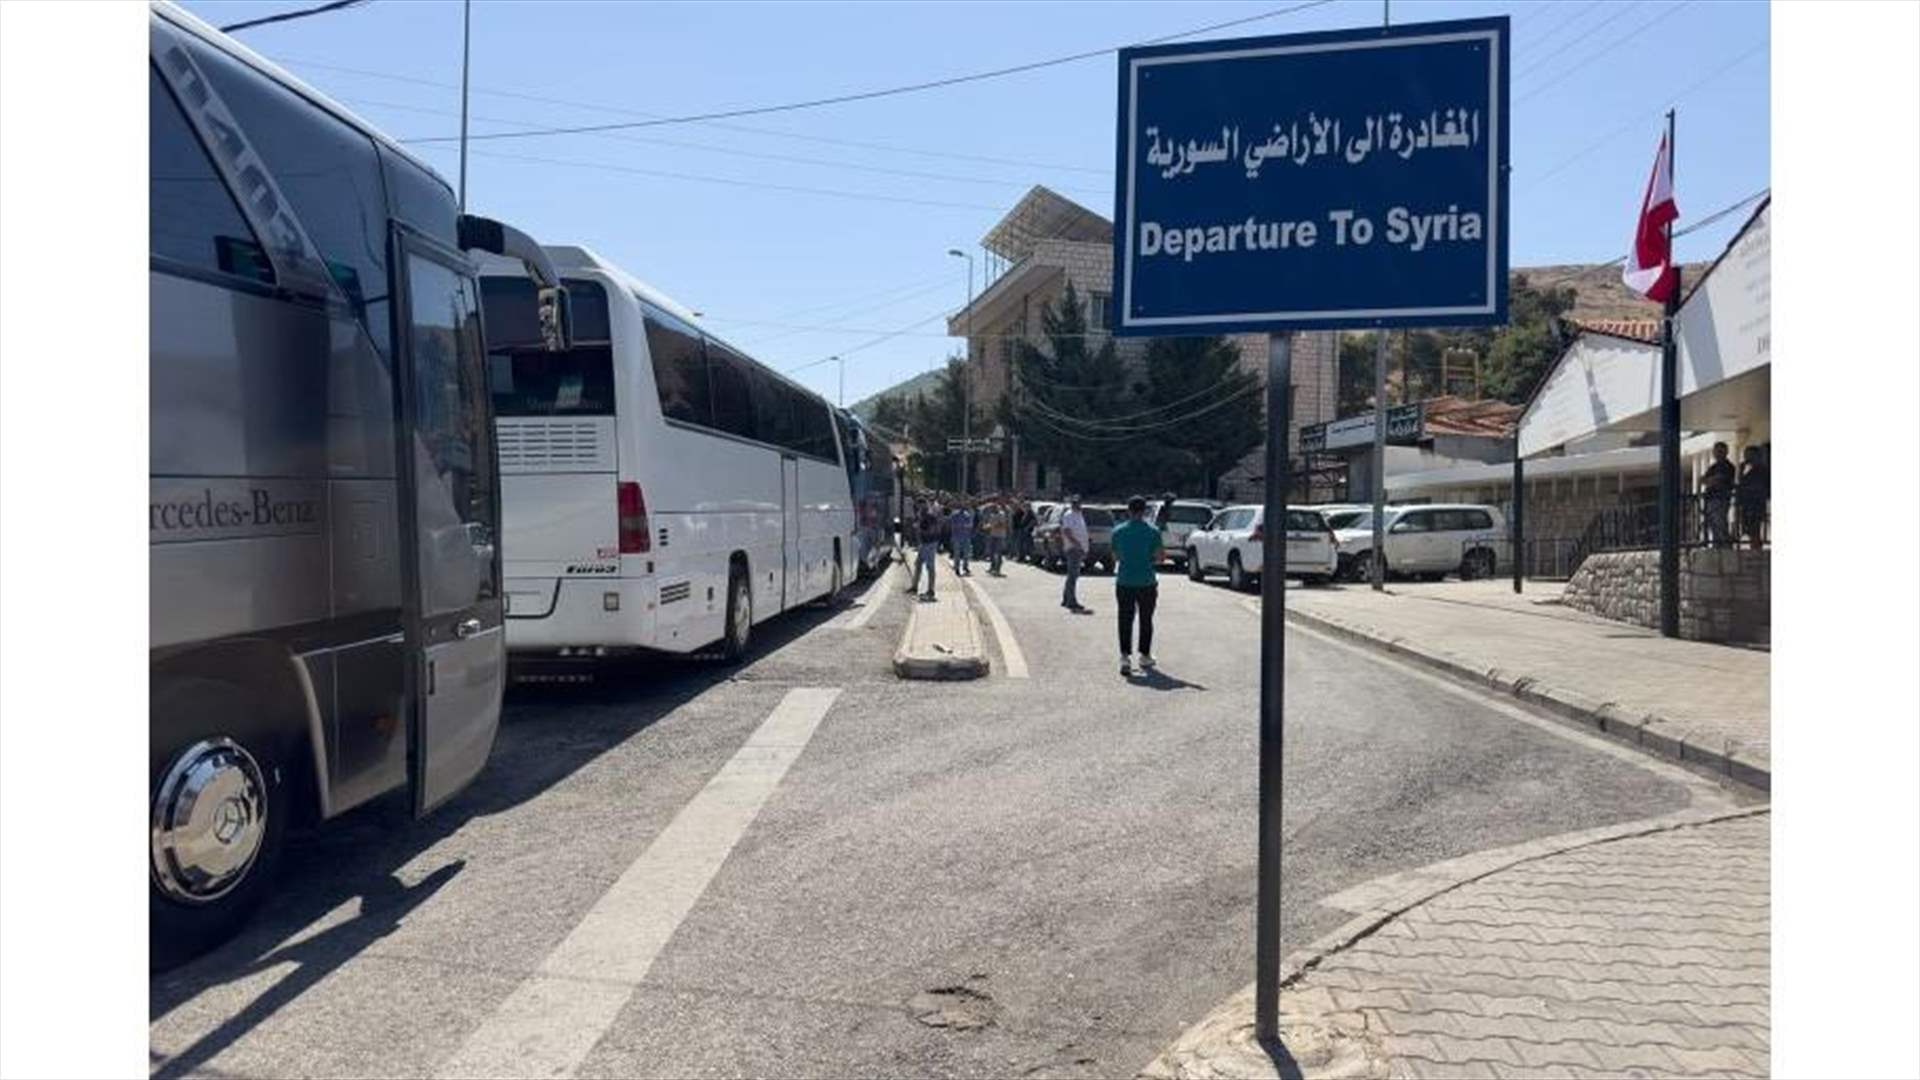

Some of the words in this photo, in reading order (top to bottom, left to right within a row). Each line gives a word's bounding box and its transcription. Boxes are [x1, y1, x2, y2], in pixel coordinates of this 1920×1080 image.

[1146, 126, 1239, 179] السورية
[1388, 108, 1479, 159] المغادرة
[1140, 217, 1317, 262] Departure
[1329, 209, 1374, 245] To
[1386, 204, 1482, 251] Syria
